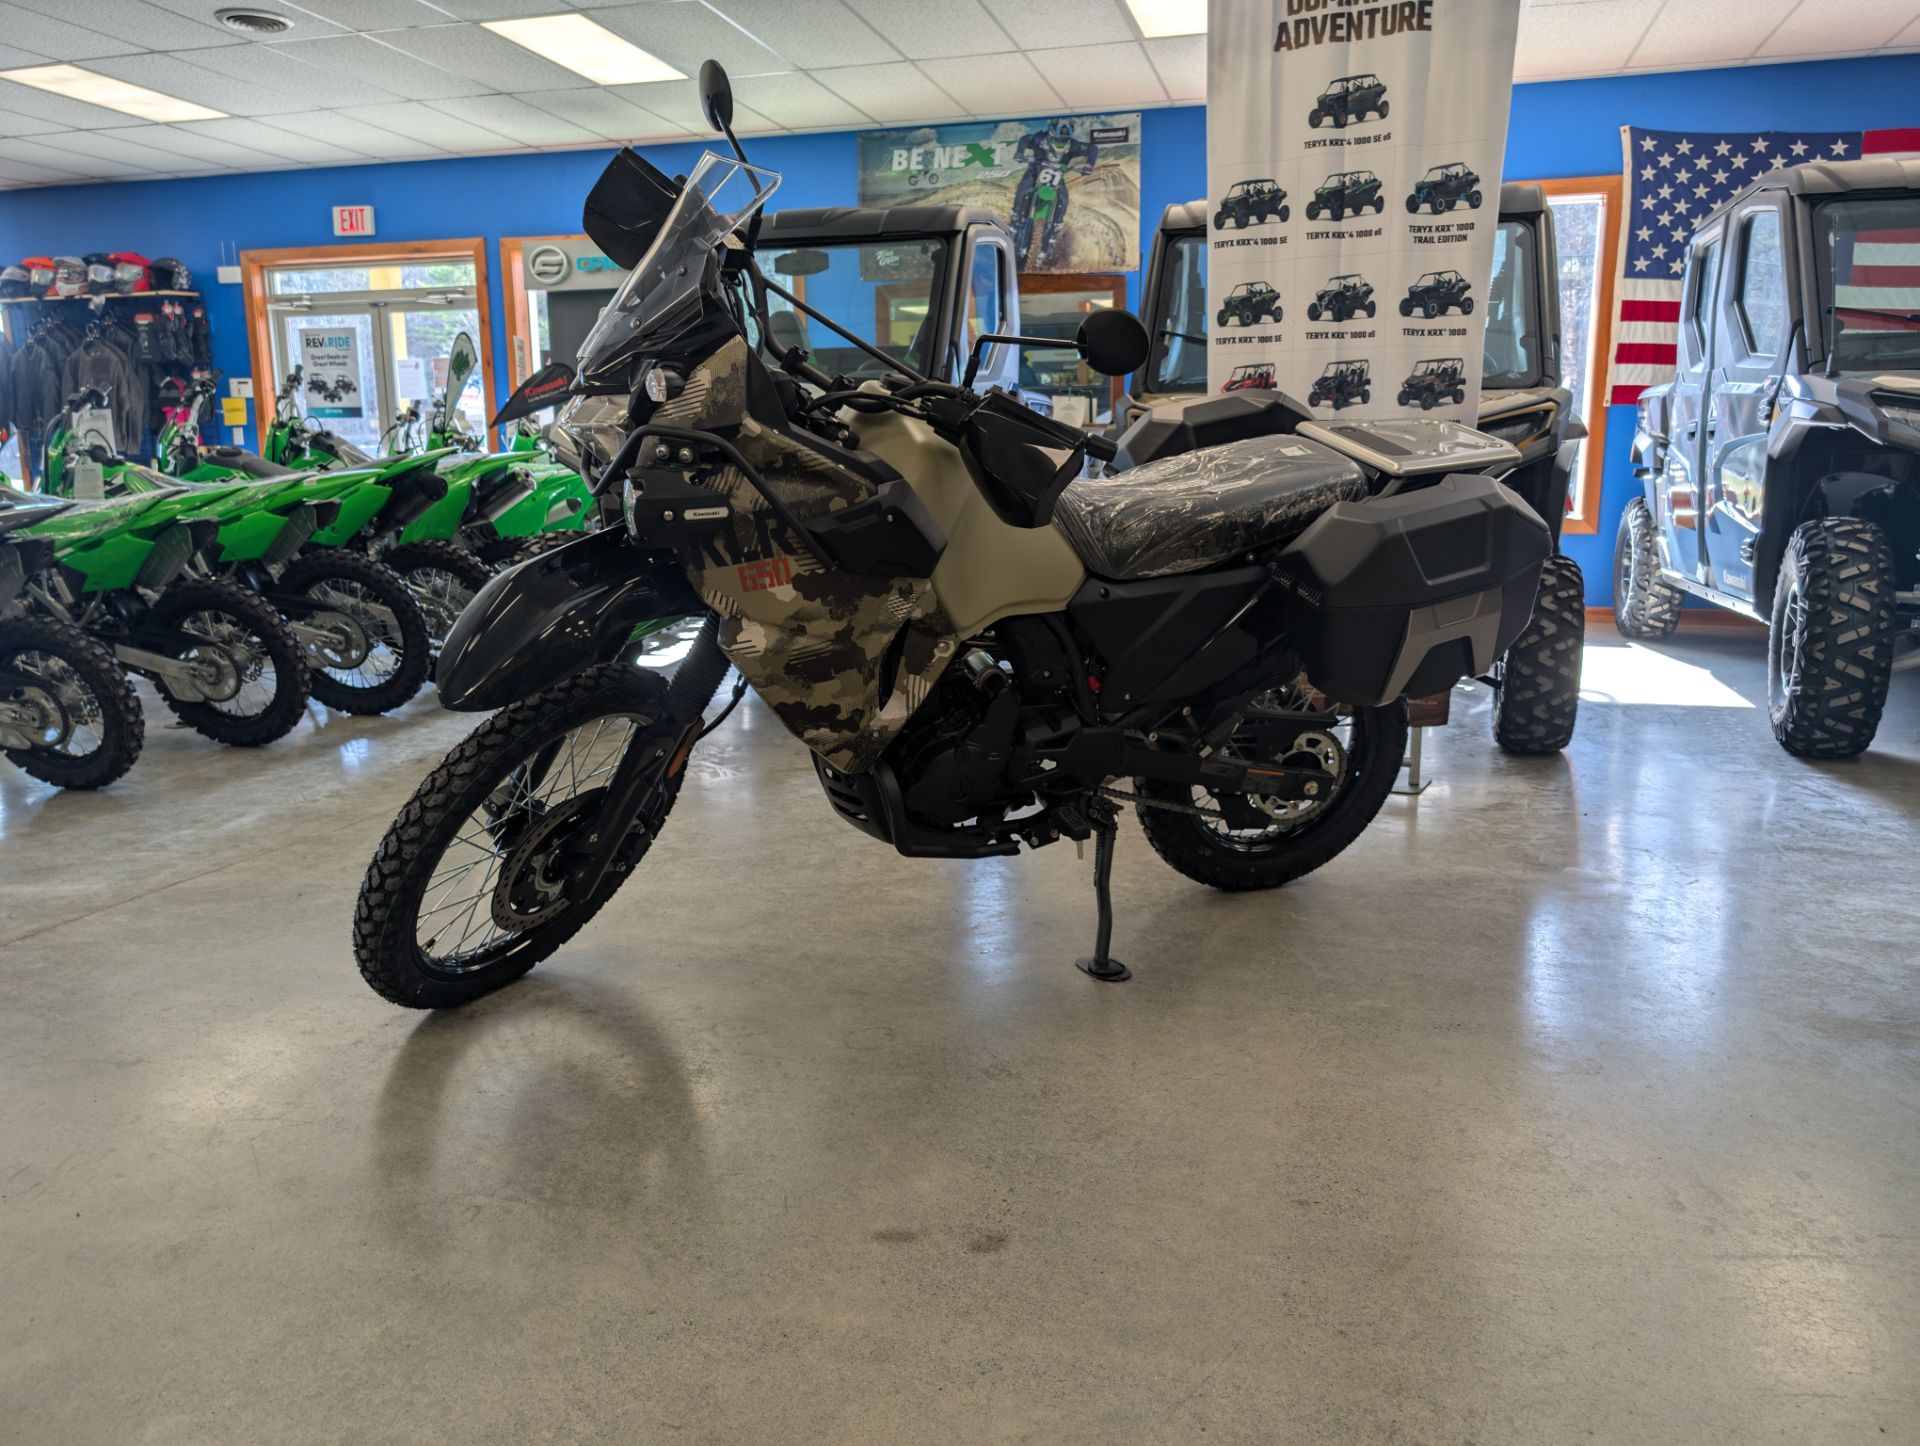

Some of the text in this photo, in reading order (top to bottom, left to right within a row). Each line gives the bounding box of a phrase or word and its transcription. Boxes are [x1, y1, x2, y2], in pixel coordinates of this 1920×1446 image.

[1274, 1, 1433, 52] ADVENTURE
[1304, 139, 1327, 149] TERYX
[1354, 136, 1371, 145] 1000
[1373, 134, 1382, 143] SE
[892, 143, 1008, 171] BE NEXT
[1039, 169, 1063, 186] 61
[340, 208, 366, 233] EXIT
[1408, 225, 1433, 233] TERYX
[1456, 222, 1475, 231] 1000
[1306, 231, 1330, 240] TERYX
[1355, 229, 1373, 238] 1000
[1413, 234, 1468, 244] TRAIL EDITION
[1214, 239, 1235, 249] TERYX
[1260, 237, 1278, 246] 1000
[1279, 235, 1288, 244] SE
[1305, 331, 1329, 340] TERYX
[1350, 331, 1367, 339] 1000
[1402, 328, 1425, 336] TERYX
[1449, 327, 1467, 336] 1000
[1215, 337, 1236, 345] TERYX
[1258, 335, 1273, 344] 1000
[1274, 334, 1283, 342] SE
[524, 376, 568, 398] Kawasaki
[738, 559, 793, 593] 650
